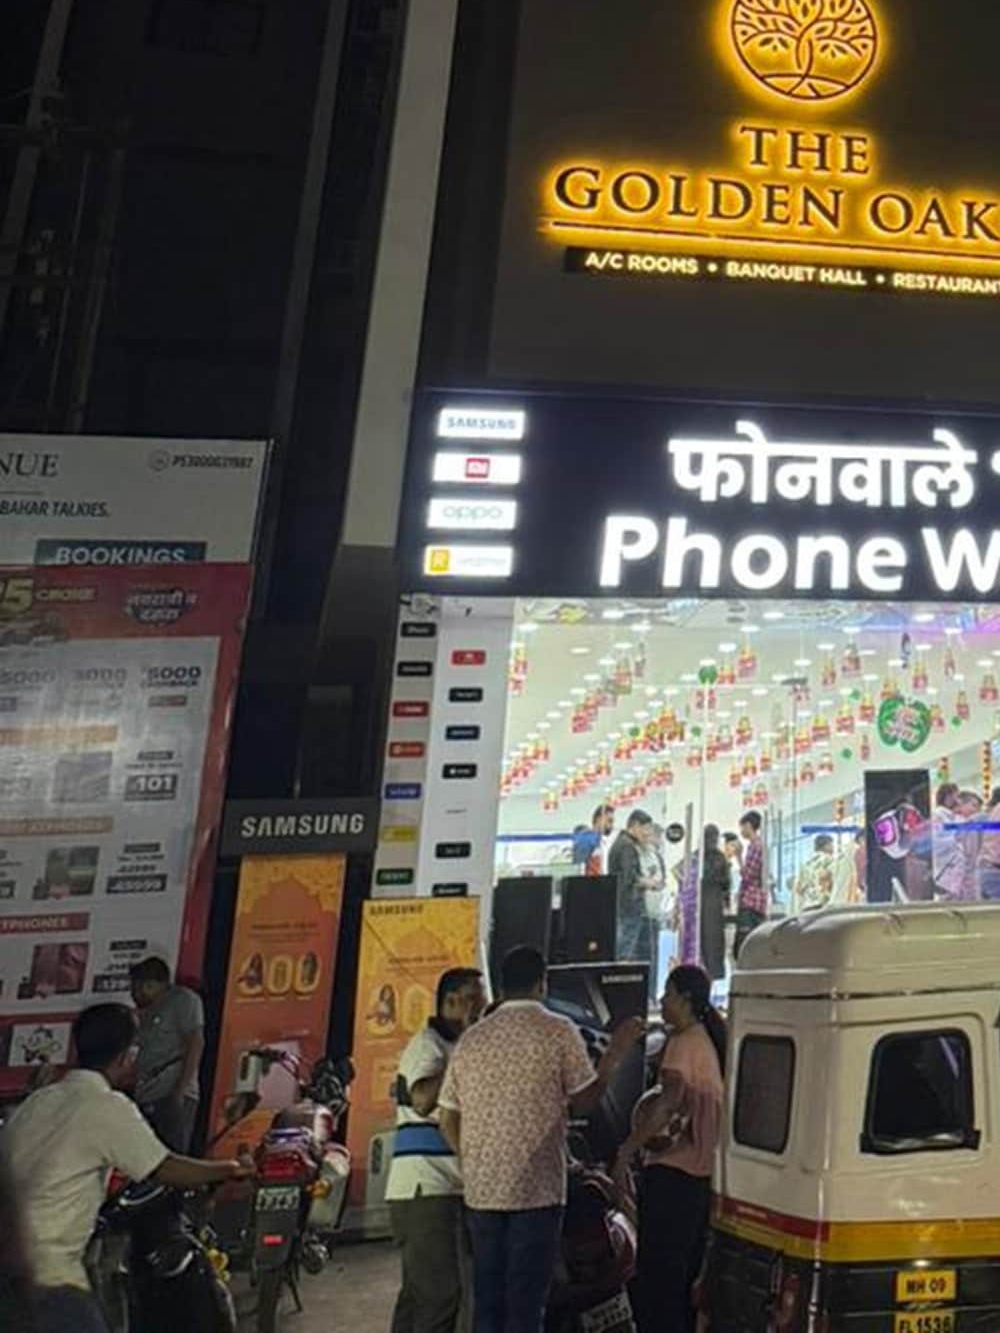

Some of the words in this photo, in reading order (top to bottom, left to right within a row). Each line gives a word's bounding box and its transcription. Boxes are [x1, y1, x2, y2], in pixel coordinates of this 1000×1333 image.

[739, 124, 870, 175] THE
[553, 166, 844, 230] GOLDEN
[585, 252, 623, 271] A/C
[628, 254, 698, 275] ROOMS
[725, 260, 815, 283] BANQUET
[820, 268, 867, 287] HALL
[446, 416, 516, 430] SAMSUNG
[667, 420, 978, 509] फोनवाले
[54, 546, 187, 566] BOOKINGS
[600, 514, 908, 594] Phone
[241, 813, 365, 838] SAMSUNG
